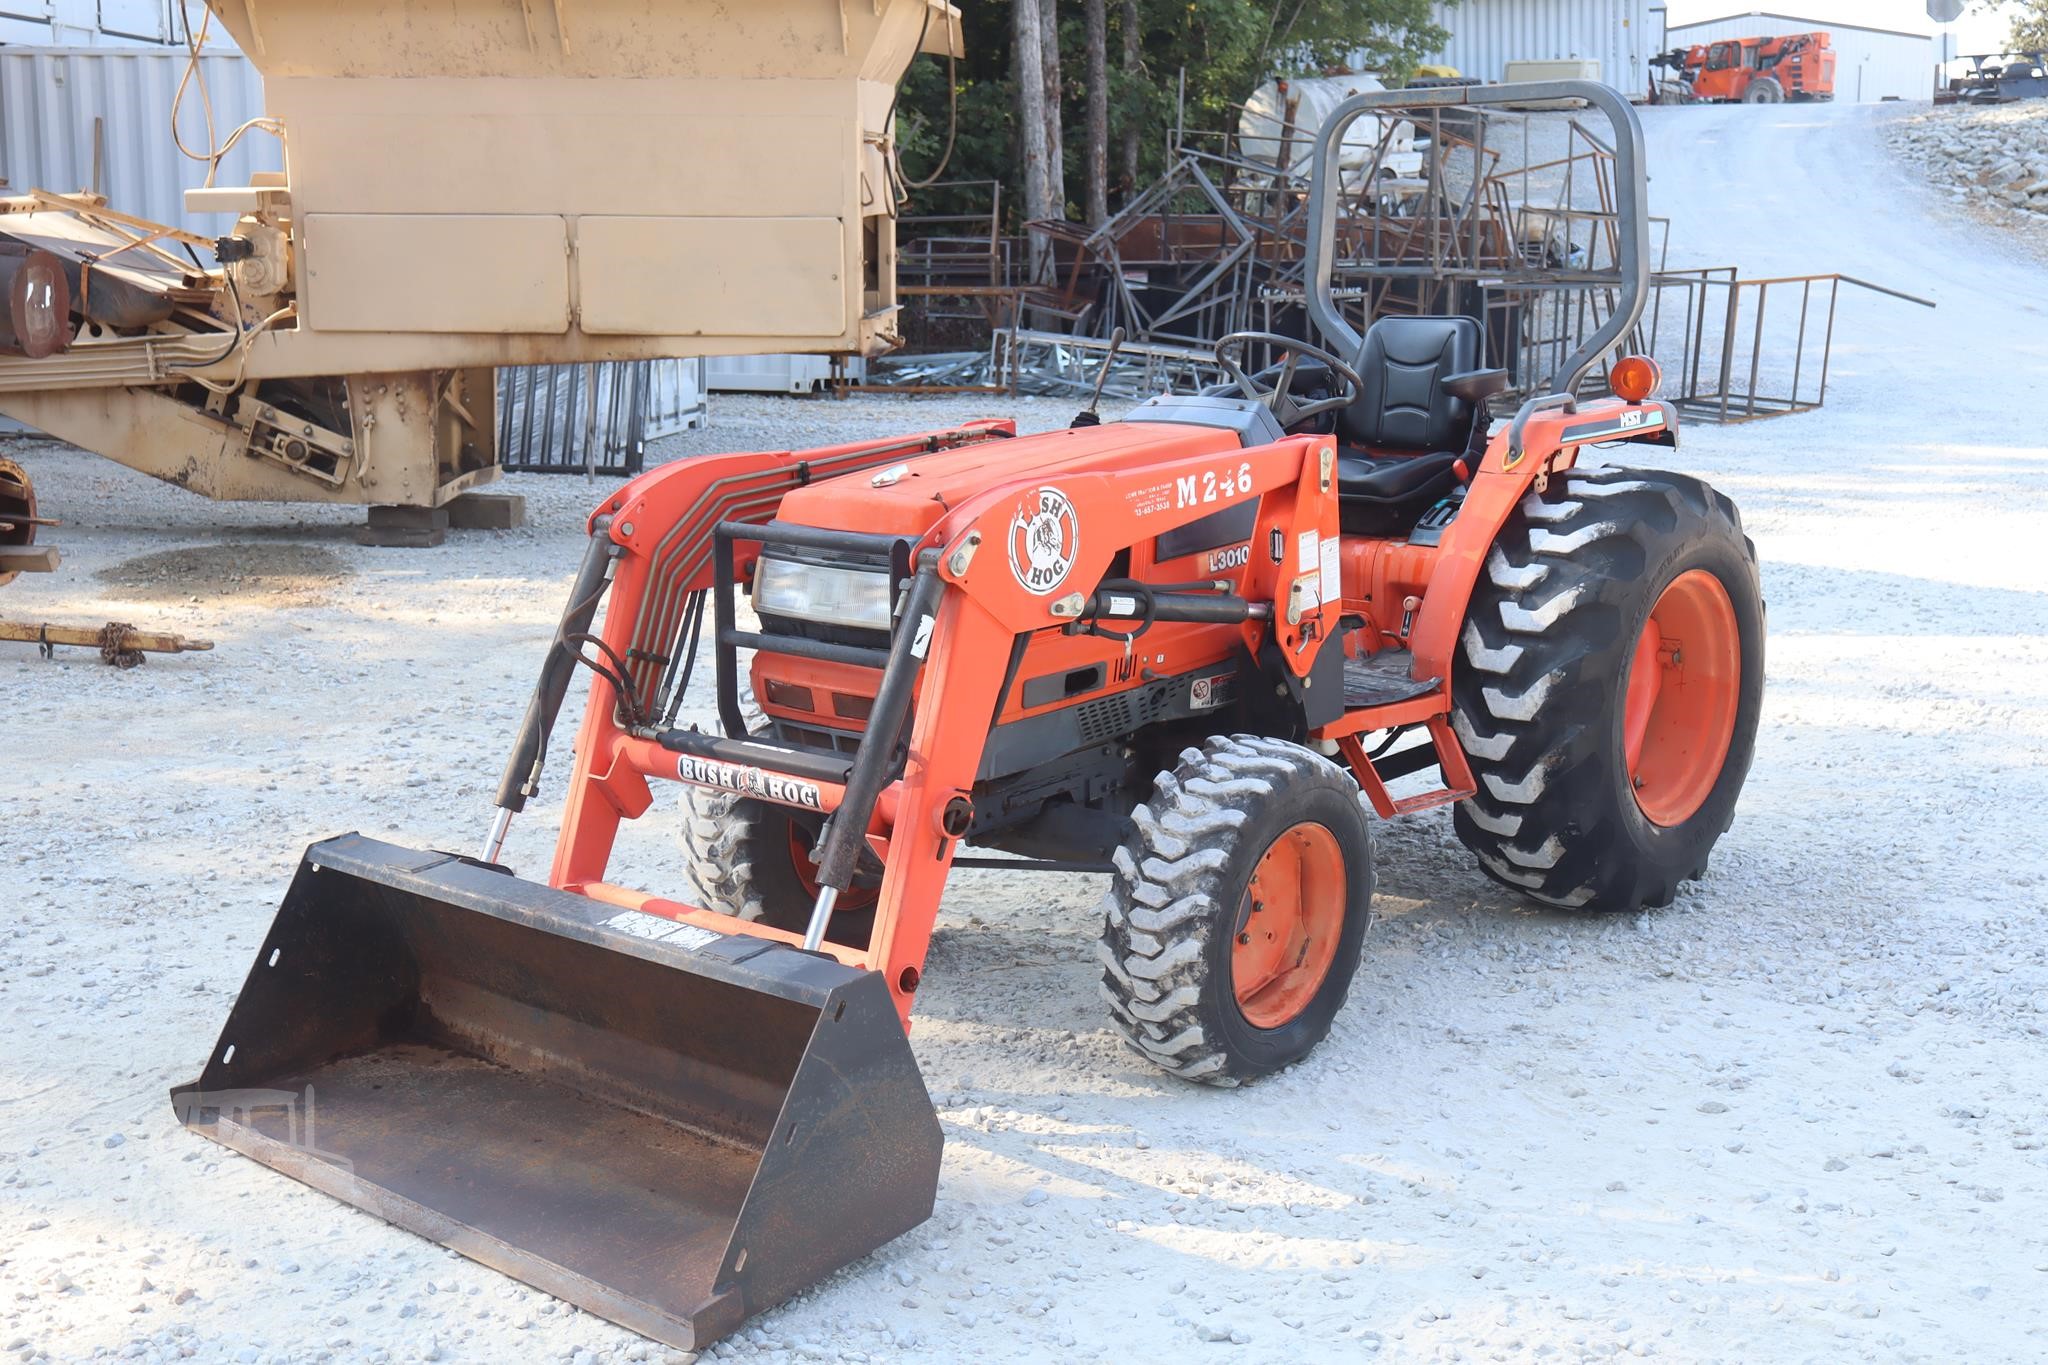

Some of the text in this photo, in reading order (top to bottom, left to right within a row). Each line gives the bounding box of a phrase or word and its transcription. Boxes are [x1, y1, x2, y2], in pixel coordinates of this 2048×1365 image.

[1620, 410, 1641, 427] HST
[1209, 545, 1250, 572] L3010
[1031, 560, 1064, 586] HOG
[683, 758, 816, 807] BUSH HOG
